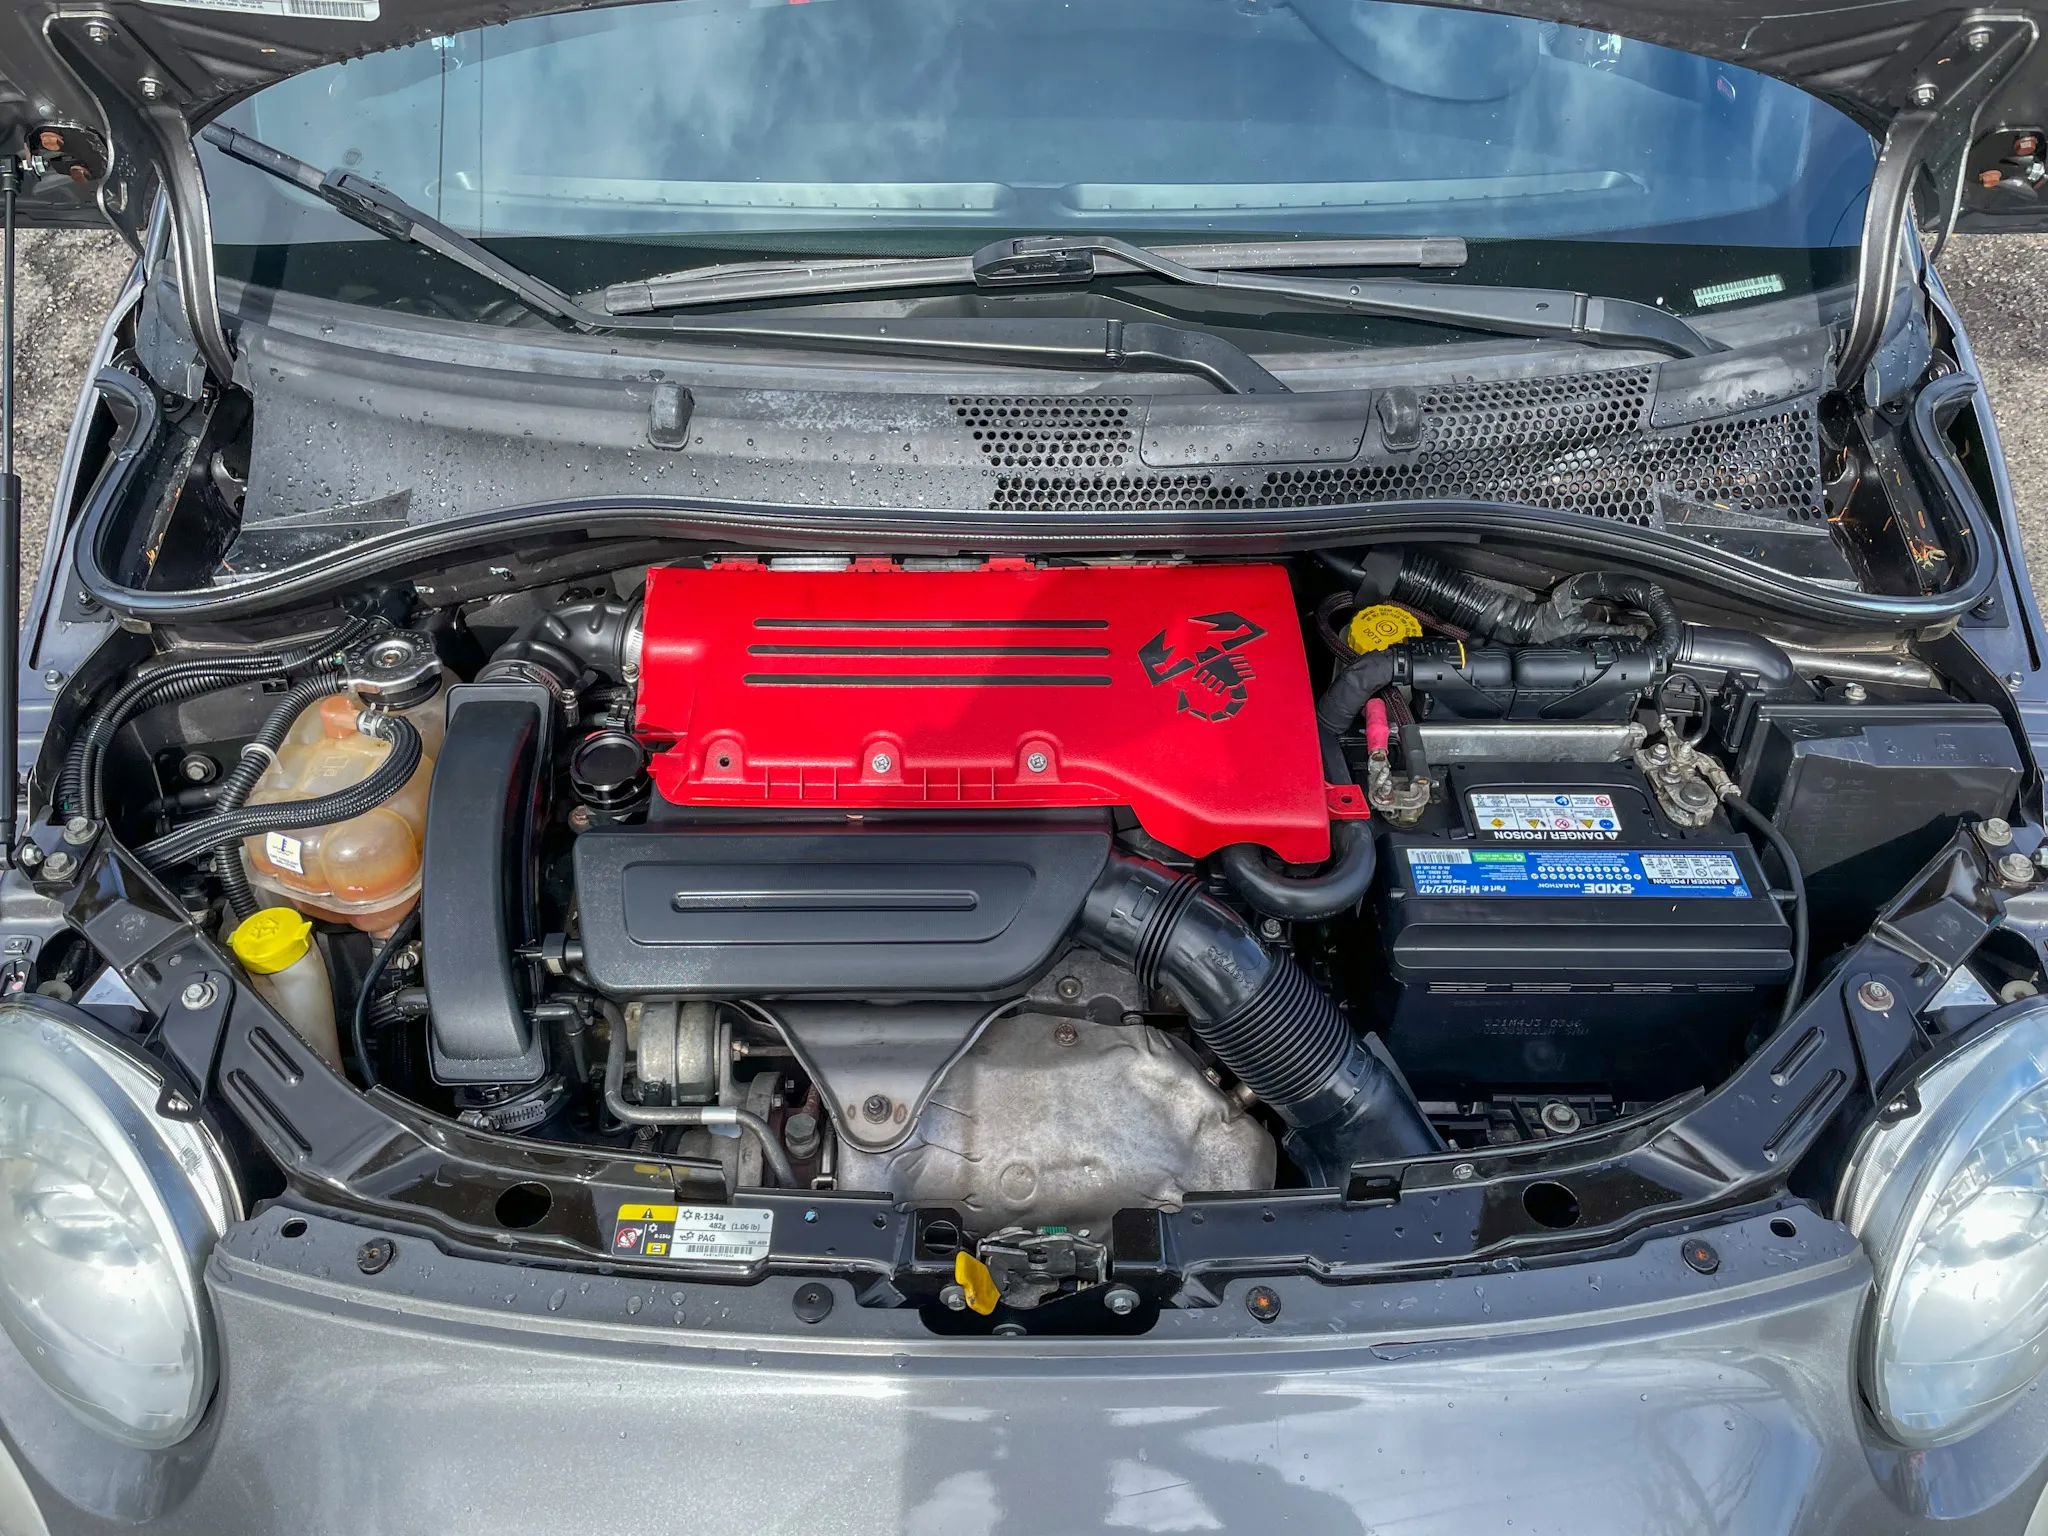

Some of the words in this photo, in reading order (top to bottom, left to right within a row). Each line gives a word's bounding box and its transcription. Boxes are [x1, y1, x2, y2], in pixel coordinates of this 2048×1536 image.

[1494, 831, 1542, 840] POISON
[1551, 831, 1604, 840] DANGER
[1419, 884, 1480, 894] M-H5/L2/47
[1491, 884, 1506, 892] Part
[1584, 883, 1634, 894] EXIDE
[694, 1213, 724, 1221] R-134a
[709, 1222, 726, 1231] 482g
[731, 1222, 749, 1231] (1.06
[750, 1223, 761, 1232] lb)
[697, 1234, 716, 1242] PAG
